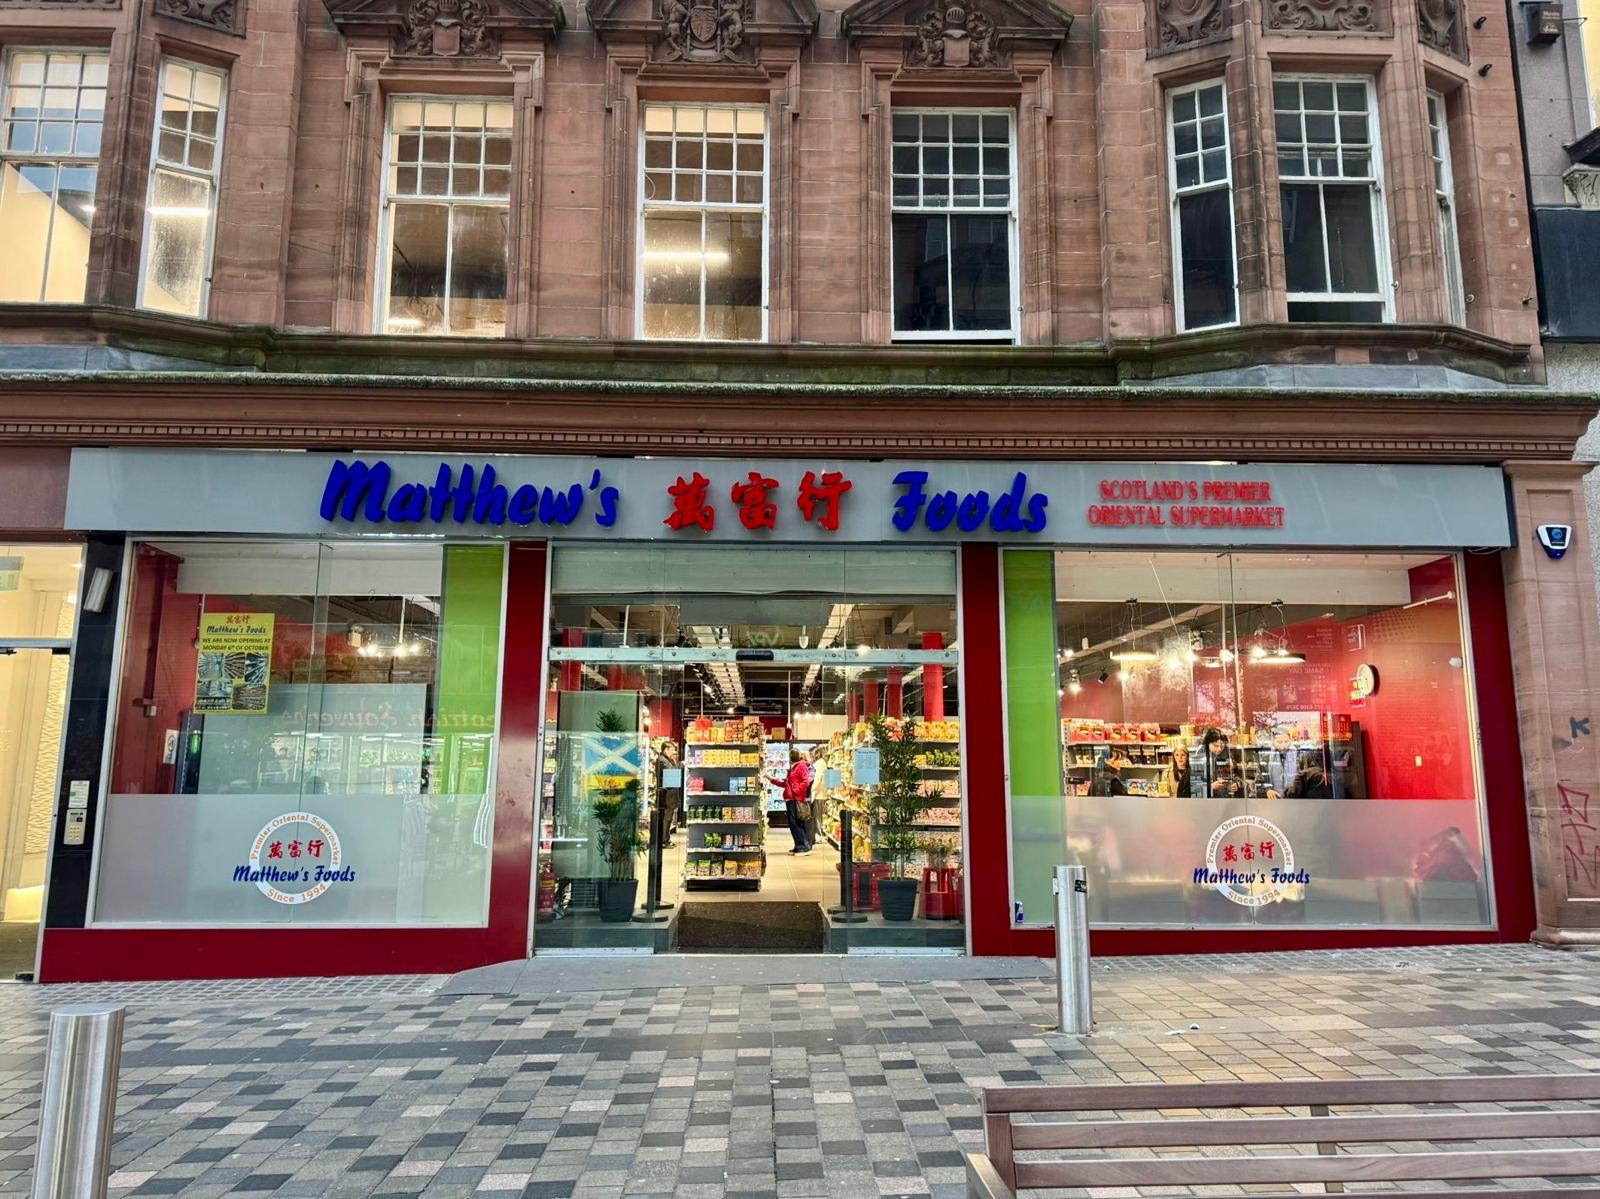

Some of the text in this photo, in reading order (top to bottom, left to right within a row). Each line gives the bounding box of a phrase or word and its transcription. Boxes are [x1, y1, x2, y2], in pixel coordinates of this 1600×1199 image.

[320, 459, 1048, 532] Matthew's Foods
[1099, 480, 1272, 501] SCOTLAND'S PREMIER
[663, 471, 852, 532] 萬富行
[1088, 504, 1285, 528] ORIENTAL SUPERMARKET
[207, 625, 266, 633] Matthew's Foods
[251, 814, 340, 865] Premier Oriental Supermarket
[268, 840, 324, 859] 萬富行
[1207, 817, 1292, 865] Premier Oriental Supermarket
[1223, 841, 1274, 861] 萬富行
[233, 865, 355, 882] Matthew's Foods
[1193, 868, 1310, 884] Matthew's Foods
[267, 884, 326, 902] Since 1994
[1227, 888, 1280, 904] Since 1994
